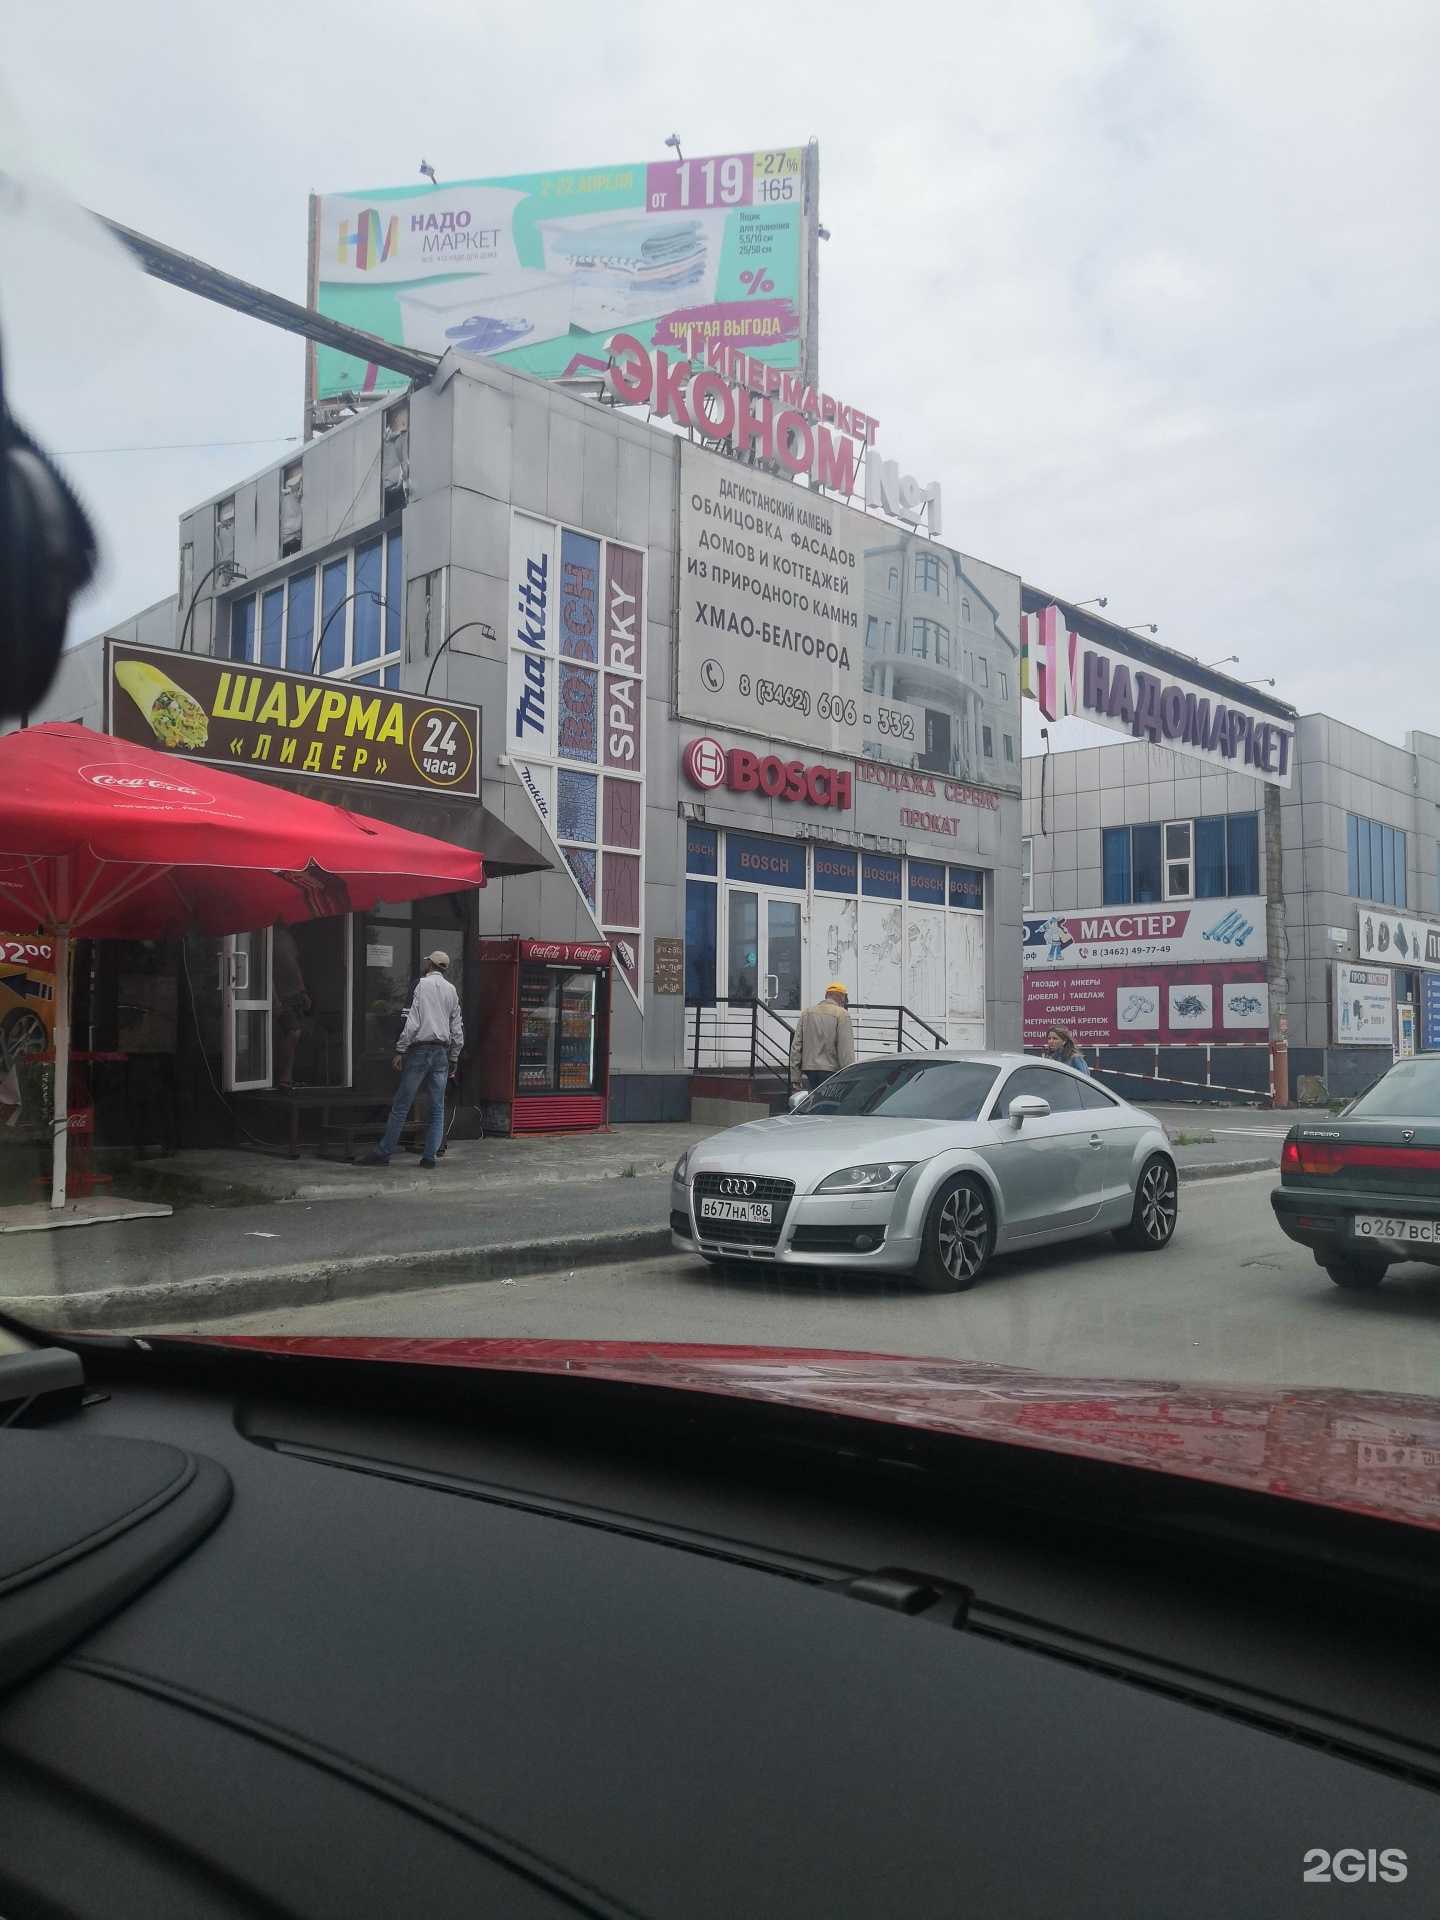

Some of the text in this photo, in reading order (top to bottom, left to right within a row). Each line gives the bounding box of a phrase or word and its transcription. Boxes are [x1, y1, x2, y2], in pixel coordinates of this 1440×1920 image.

[754, 153, 798, 174] -27%
[676, 158, 743, 206] 119
[759, 178, 792, 202] 165
[411, 211, 470, 232] НАДО
[422, 229, 500, 253] МАРКЕТ
[670, 318, 782, 338] ЧИСТАЯ ВЫГОДА
[687, 330, 880, 447] ГИПЕРМАРКЕТ
[603, 333, 856, 497] ЭКОНОМ
[719, 478, 833, 537] ДАГИСТАНСКИЙ КАМЕНЬ
[691, 494, 856, 568] ОБЛИЦОВКА ФАСАДОВ
[698, 529, 849, 596] ДОМОВ И КОТТЕДЖЕЙ
[687, 556, 858, 628] ИЗ ПРИРОДНОГО КАМНЯ
[694, 600, 851, 672] ХМАО-БЕЛГОРОД
[560, 561, 594, 752] BOSCH
[608, 577, 636, 761] SPARKY
[212, 672, 404, 746] ШАУРМА
[737, 673, 751, 697] 8
[756, 678, 812, 717] (3462)
[816, 692, 858, 726] 606
[877, 707, 915, 742] 332
[1083, 650, 1295, 778] НАДОМАРКЕТ
[423, 716, 458, 756] 24
[423, 756, 457, 776] часа
[727, 748, 852, 810] BOSCH
[856, 761, 1001, 812] ПРОДАЖА СЕРВИС
[899, 807, 959, 837] ПРОКАТ
[740, 851, 789, 873] BOSCH
[816, 861, 857, 877] BOSCH
[863, 866, 901, 884] BOSCH
[911, 874, 945, 891] BOSCH
[949, 880, 982, 896] BOSCH
[1081, 915, 1177, 939] МАСТЕР
[616, 943, 634, 970] SPARKY
[1100, 947, 1129, 957] (3462)
[1132, 944, 1171, 955] 49-77-49
[1027, 992, 1104, 1001] ДЮБЕЛЯ ТАКЕЛАЖ
[1032, 979, 1100, 988] ГВОЗДИ АНКЕРЫ
[1024, 1017, 1108, 1026] МЕТРИЧЕСКИЙ КРЕПЕЖ
[750, 1203, 769, 1217] 186
